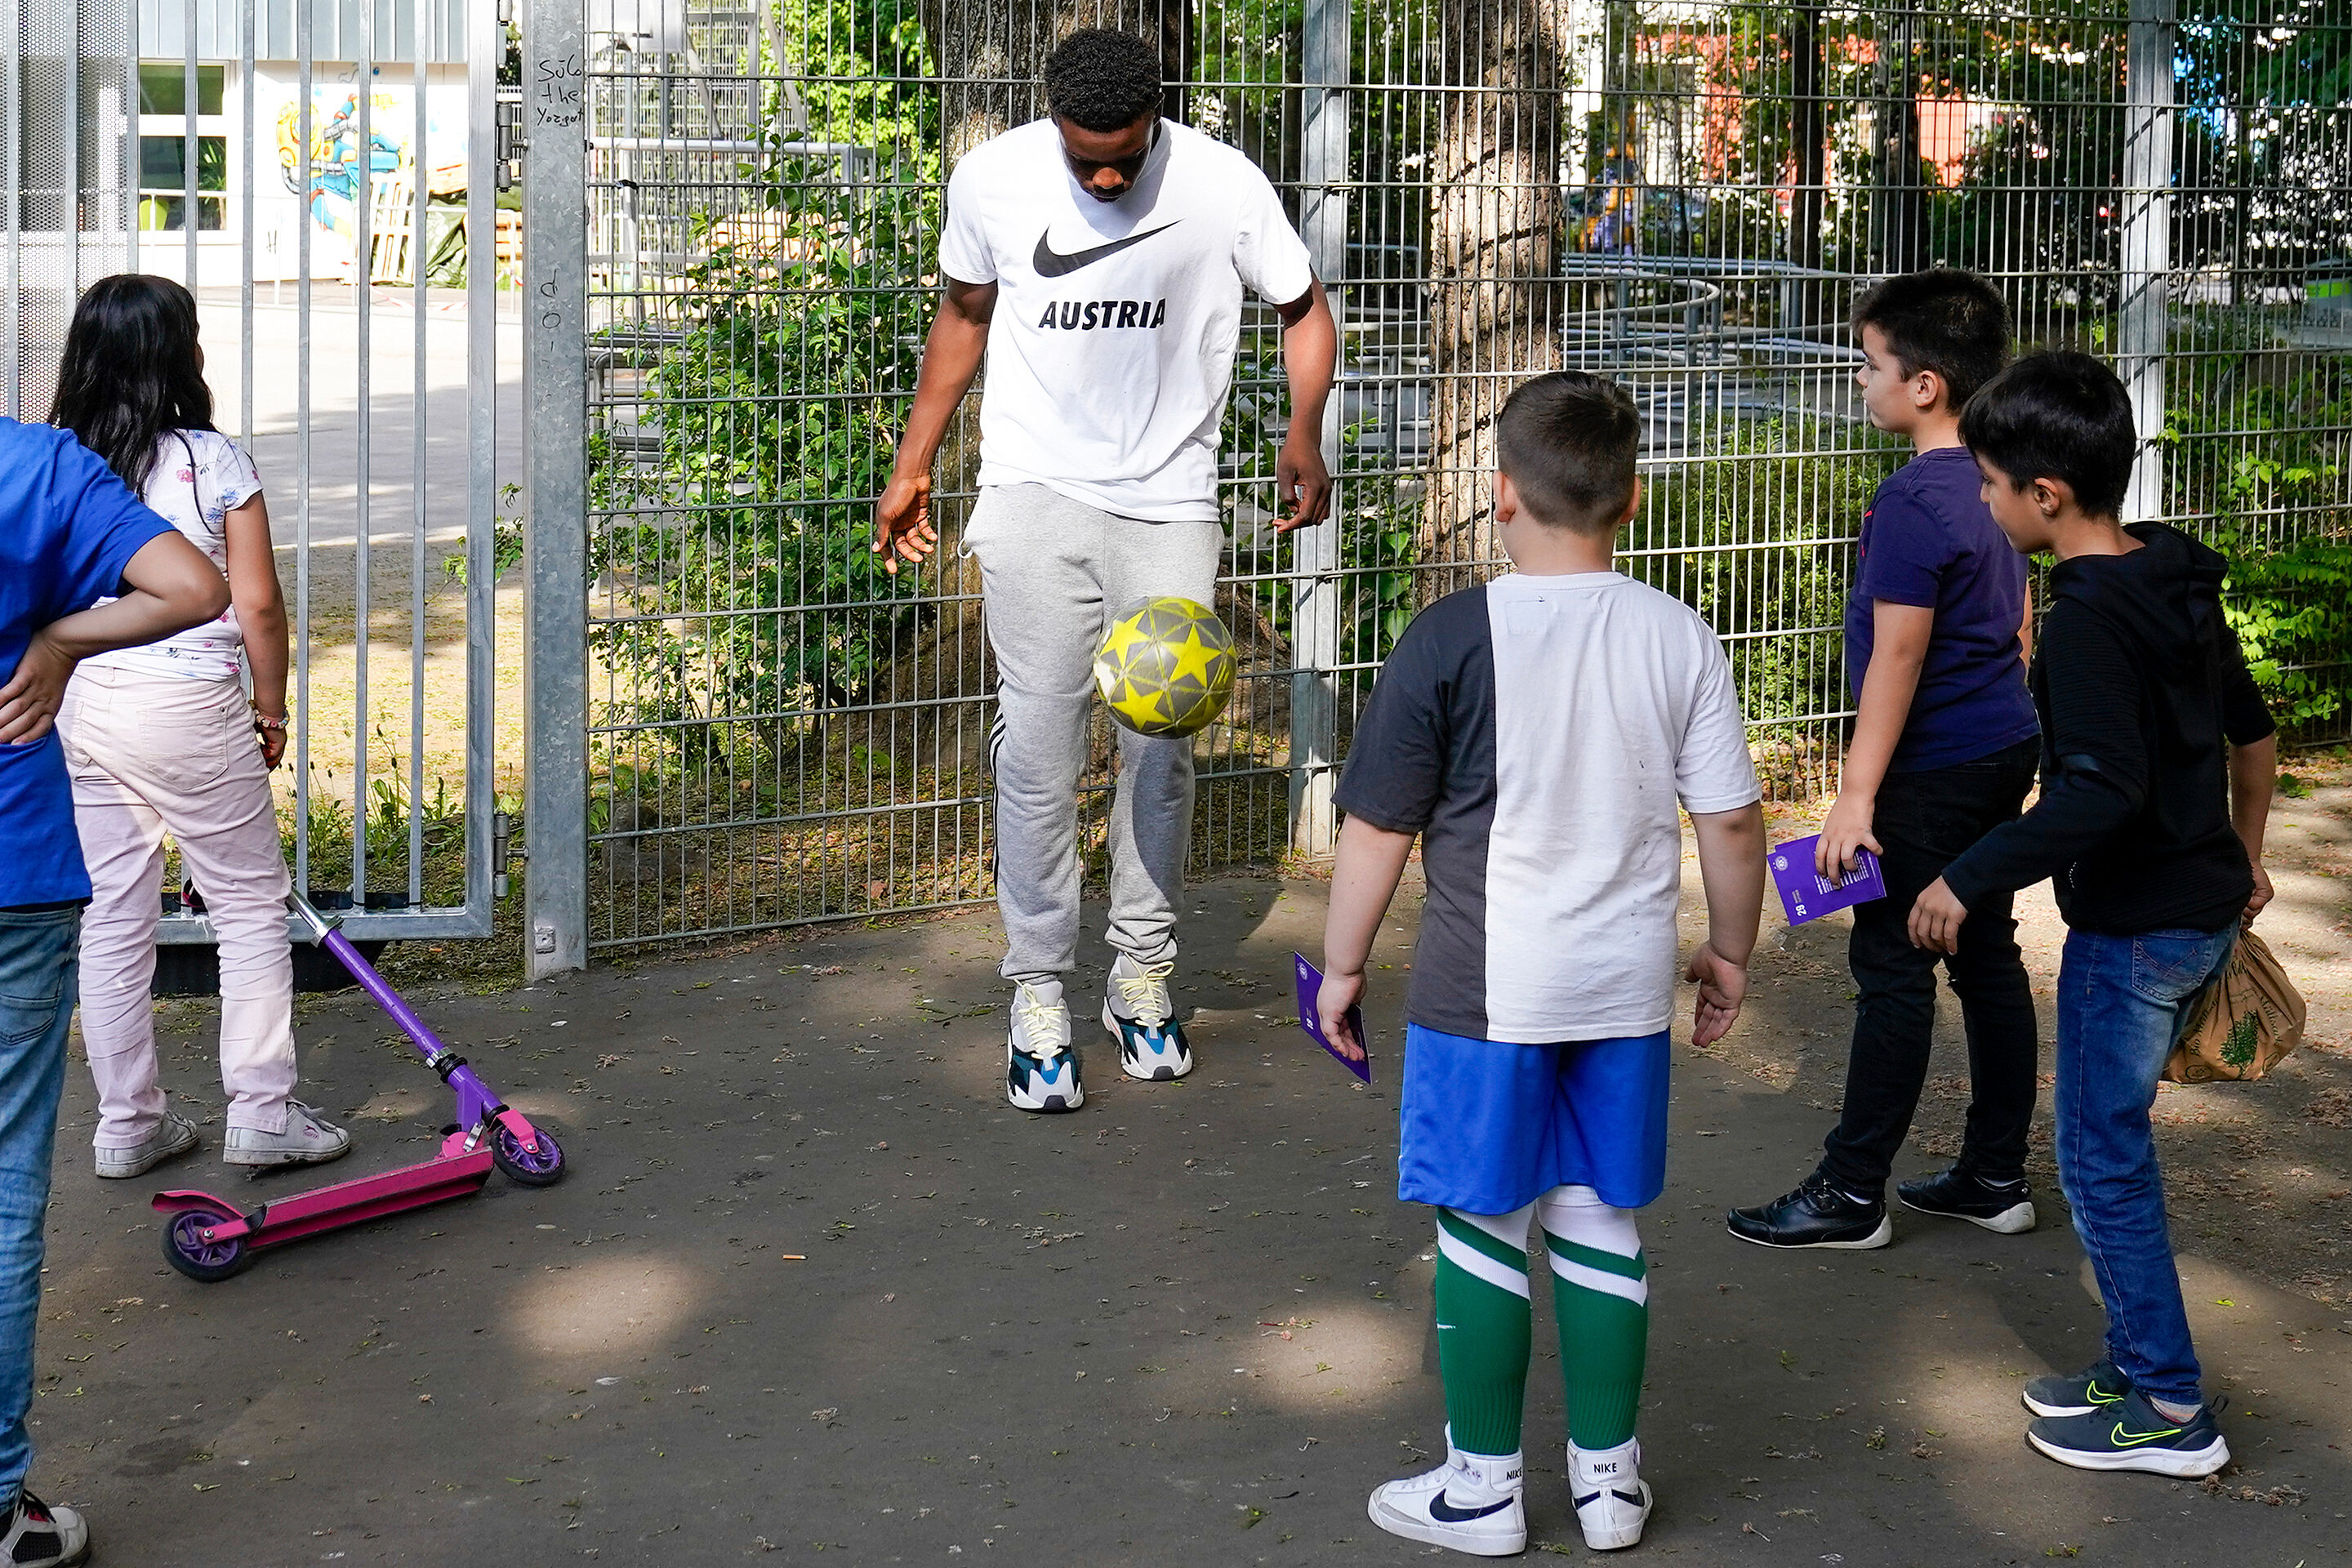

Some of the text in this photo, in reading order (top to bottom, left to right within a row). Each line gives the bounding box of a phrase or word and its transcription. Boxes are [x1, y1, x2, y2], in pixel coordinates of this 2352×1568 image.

[541, 82, 579, 105] the
[1038, 297, 1166, 331] AUSTRIA
[1506, 1465, 1522, 1481] NIKE
[1593, 1462, 1617, 1473] NIKE
